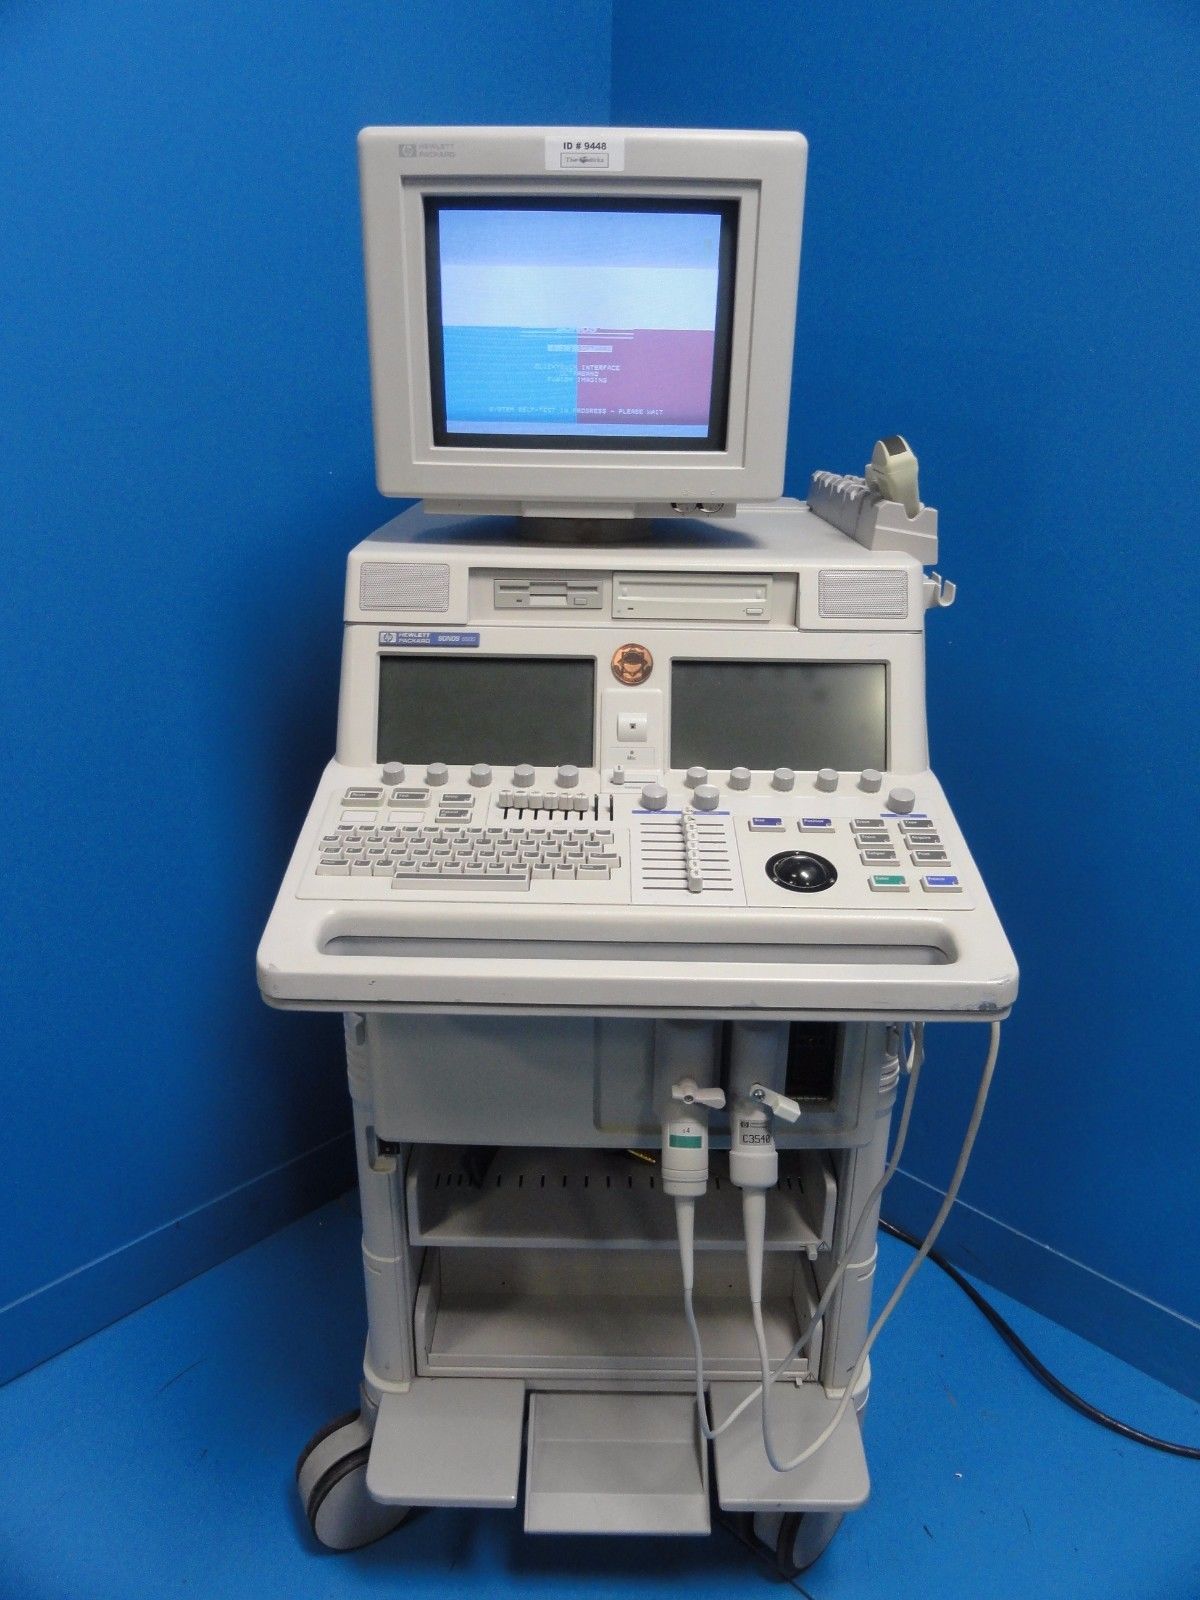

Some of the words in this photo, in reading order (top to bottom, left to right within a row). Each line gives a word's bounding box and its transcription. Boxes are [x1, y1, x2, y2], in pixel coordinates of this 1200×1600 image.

[563, 142, 573, 150] ID
[575, 142, 582, 150] #
[584, 142, 607, 150] 9448
[572, 407, 607, 415] PROGRESS
[742, 1134, 771, 1144] C3540
